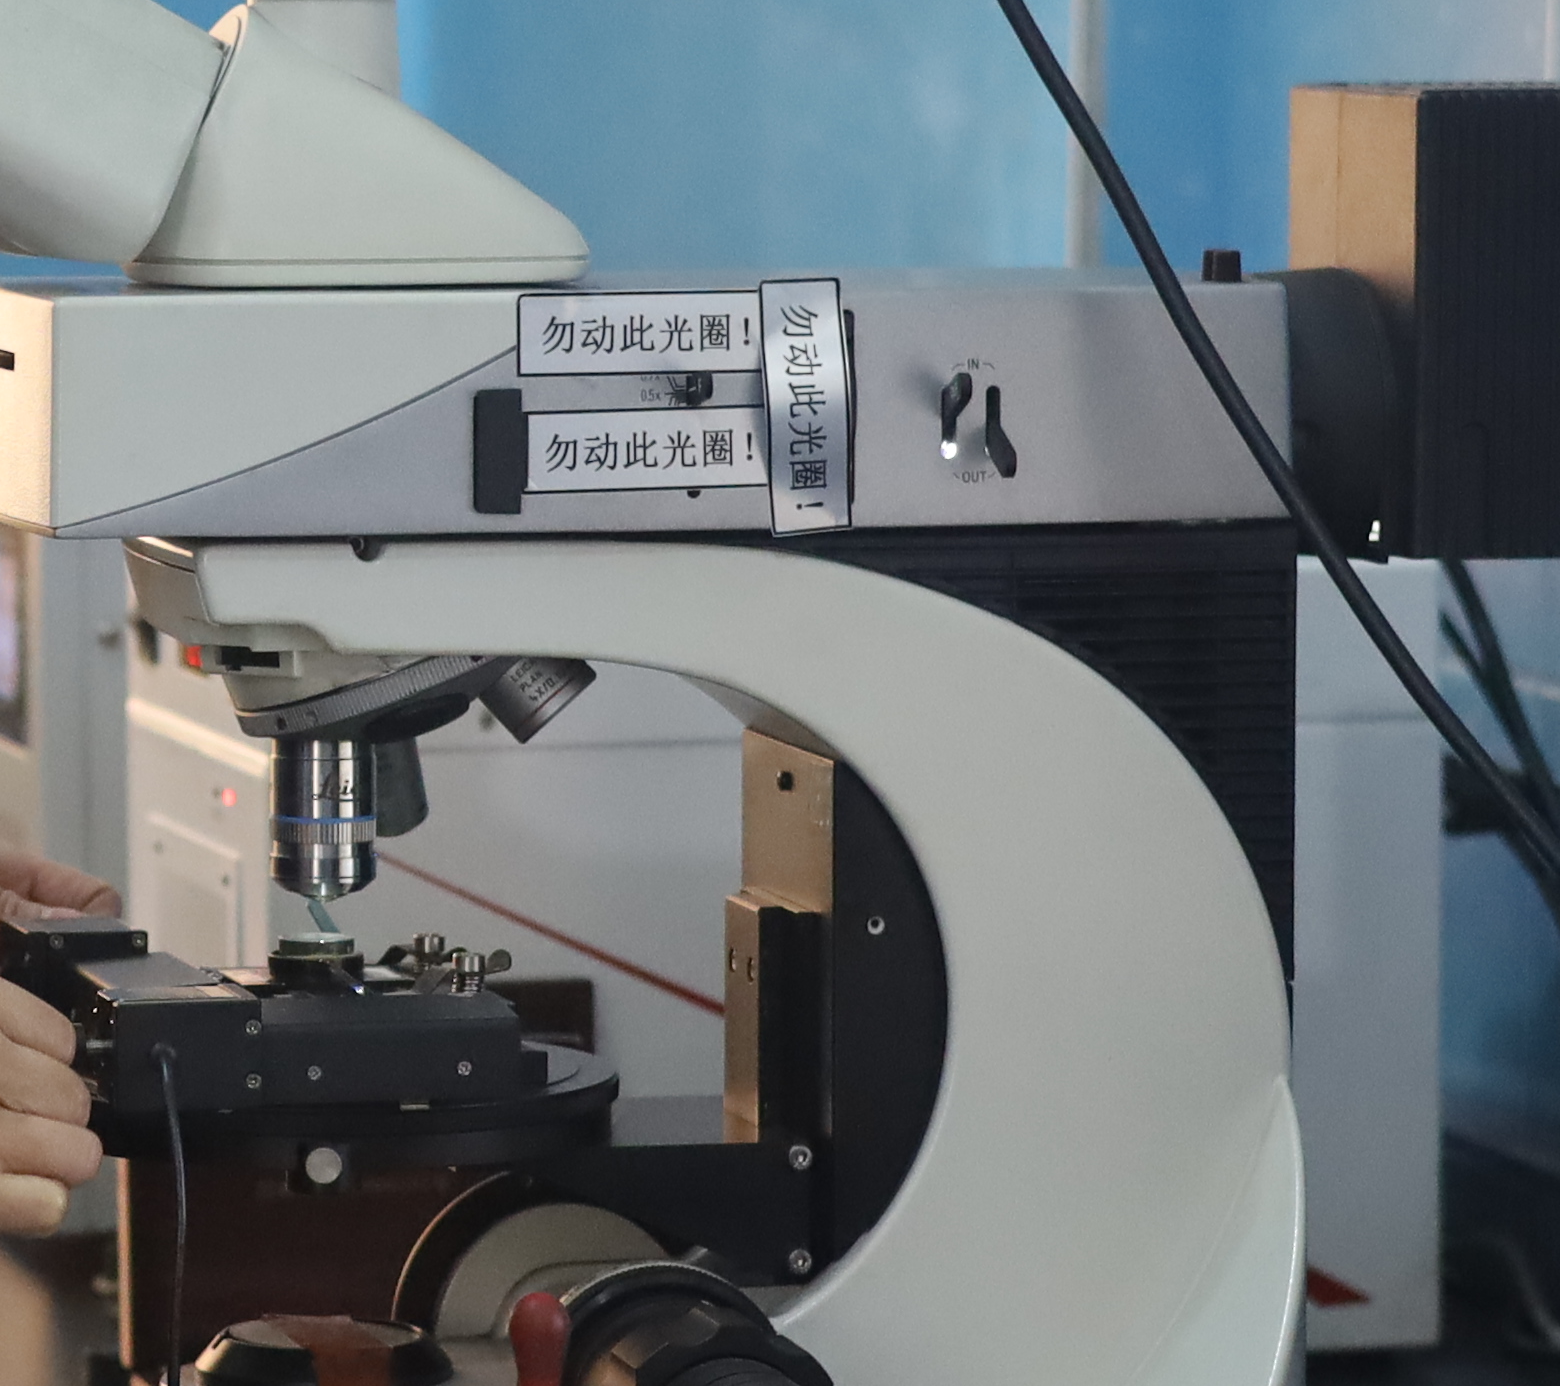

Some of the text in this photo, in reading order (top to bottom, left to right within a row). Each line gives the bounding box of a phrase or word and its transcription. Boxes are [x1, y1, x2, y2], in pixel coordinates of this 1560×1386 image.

[541, 313, 751, 355] 勿动此光圈！
[967, 357, 981, 370] IN
[780, 303, 829, 512] 勿动此光圈！
[544, 428, 755, 473] 勿动此光圈！
[961, 470, 988, 483] OUT
